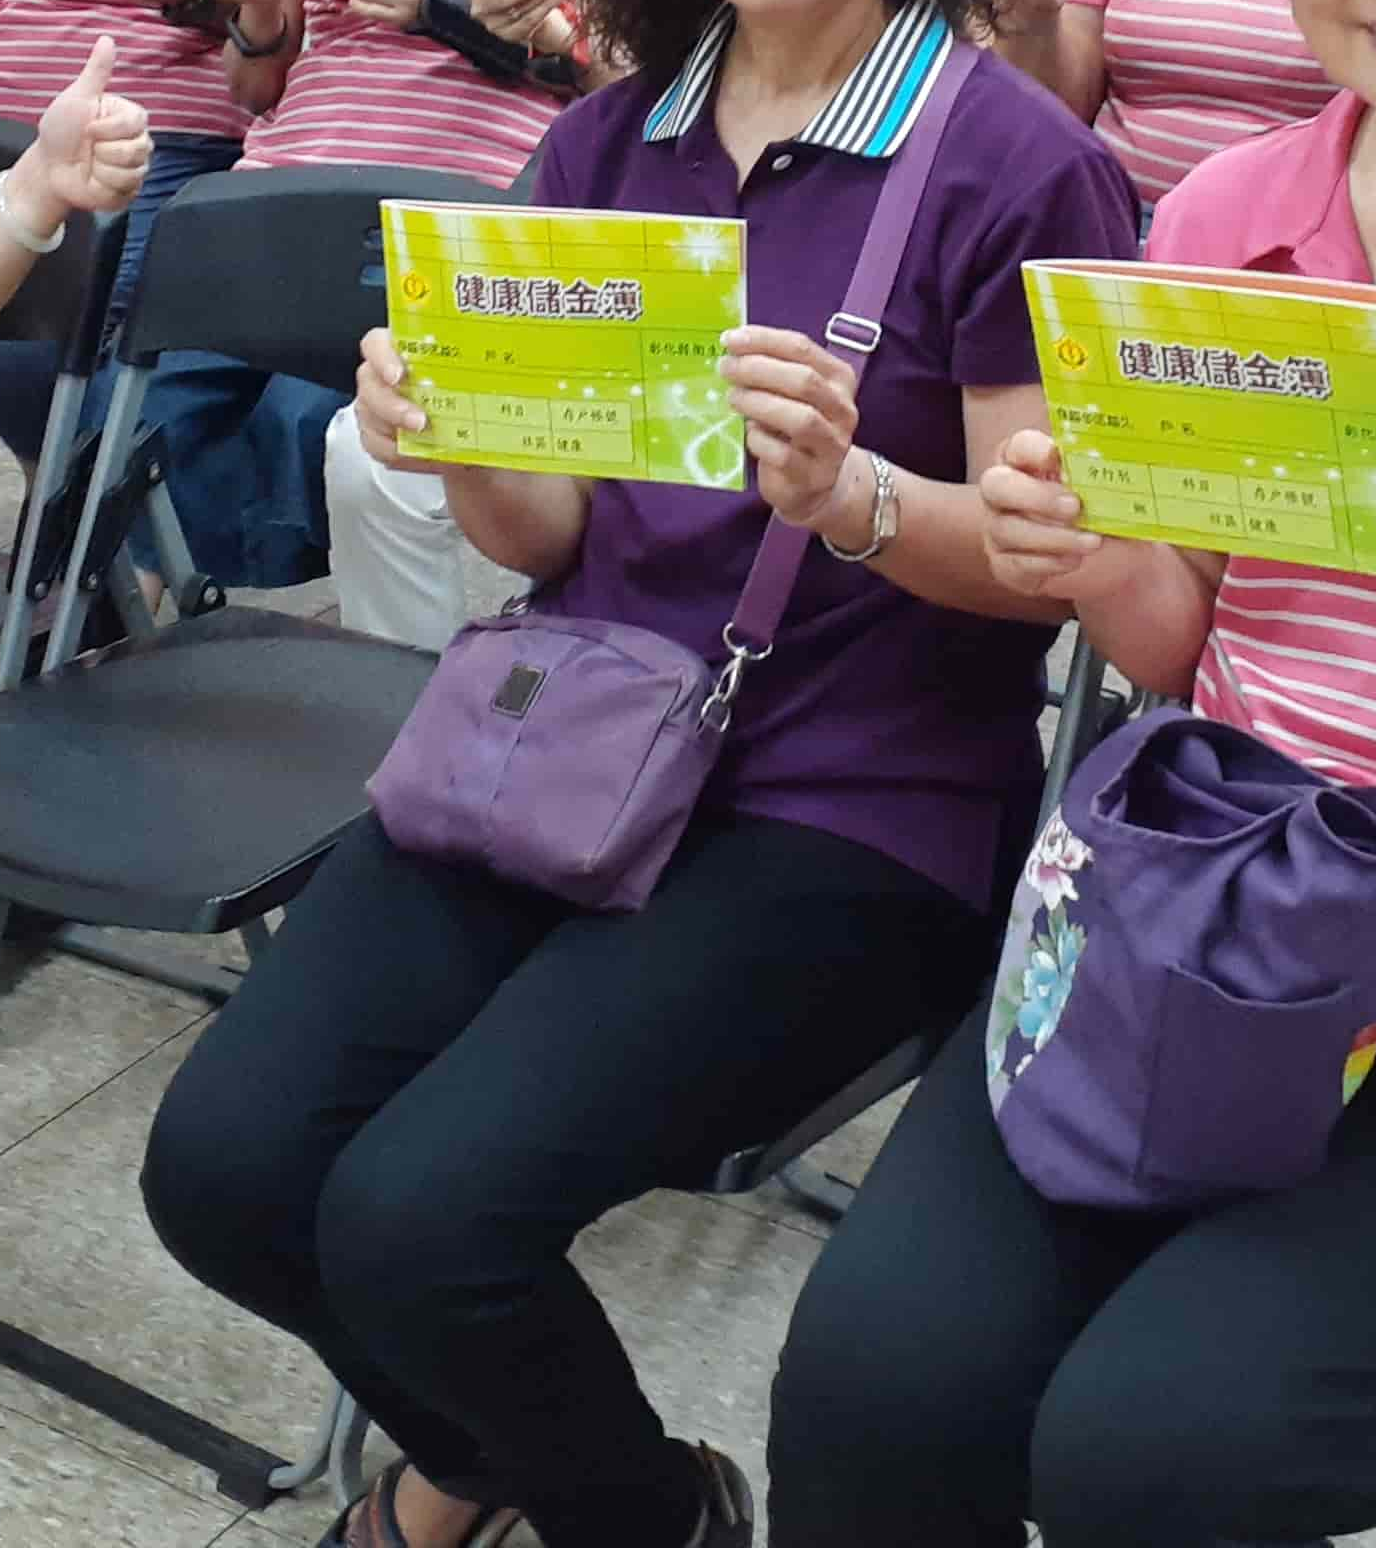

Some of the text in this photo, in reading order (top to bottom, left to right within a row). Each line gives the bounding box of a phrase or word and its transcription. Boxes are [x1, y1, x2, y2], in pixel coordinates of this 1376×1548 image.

[456, 273, 643, 320] 健康儲金簿
[1119, 339, 1333, 400] 健康儲金簿
